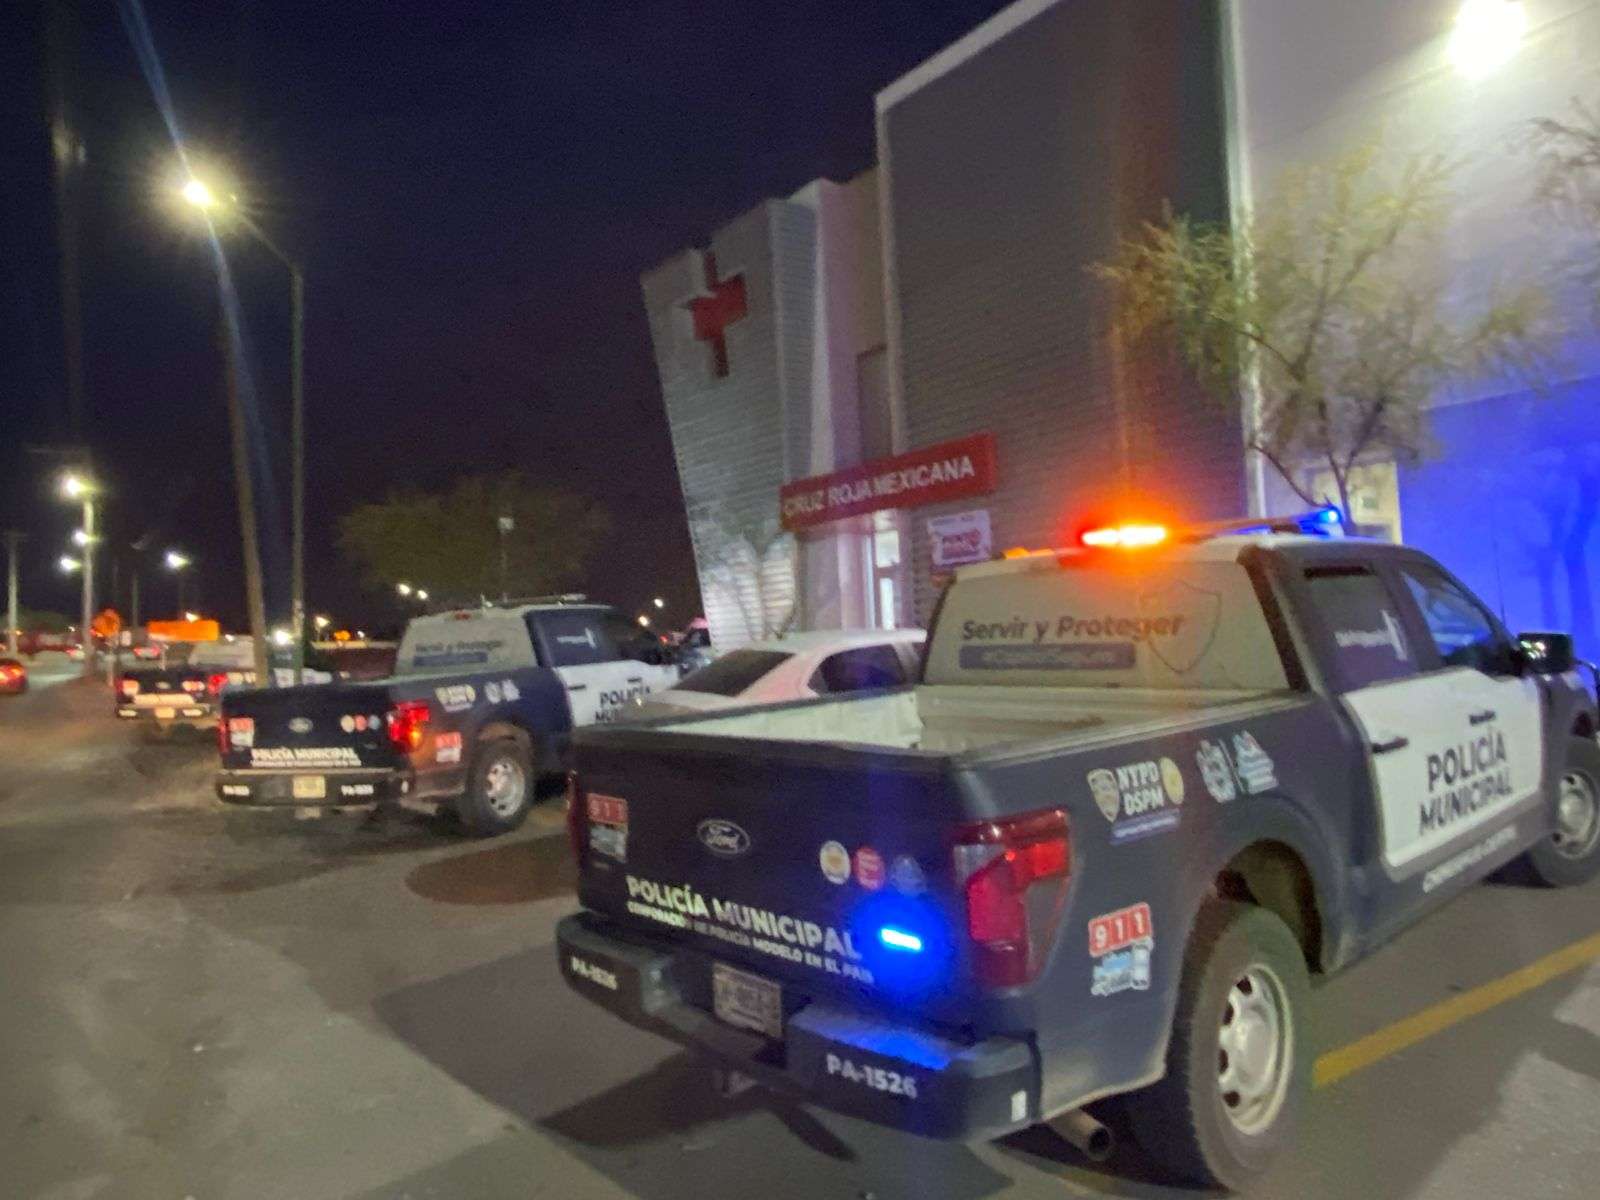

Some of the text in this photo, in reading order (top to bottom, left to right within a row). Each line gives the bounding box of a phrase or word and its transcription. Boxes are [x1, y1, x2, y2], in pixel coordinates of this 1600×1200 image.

[827, 481, 873, 506] ROJA
[873, 455, 975, 496] MEXICANA
[962, 614, 1183, 643] Servir y Proteger
[1427, 725, 1507, 793] POLICÍA
[1124, 785, 1164, 816] DSPM
[1419, 767, 1513, 836] MUNICIPAL
[626, 874, 862, 961] POLICÍA MUNICIPAL
[1095, 911, 1144, 949] 911
[826, 1053, 917, 1099] PA-1526
